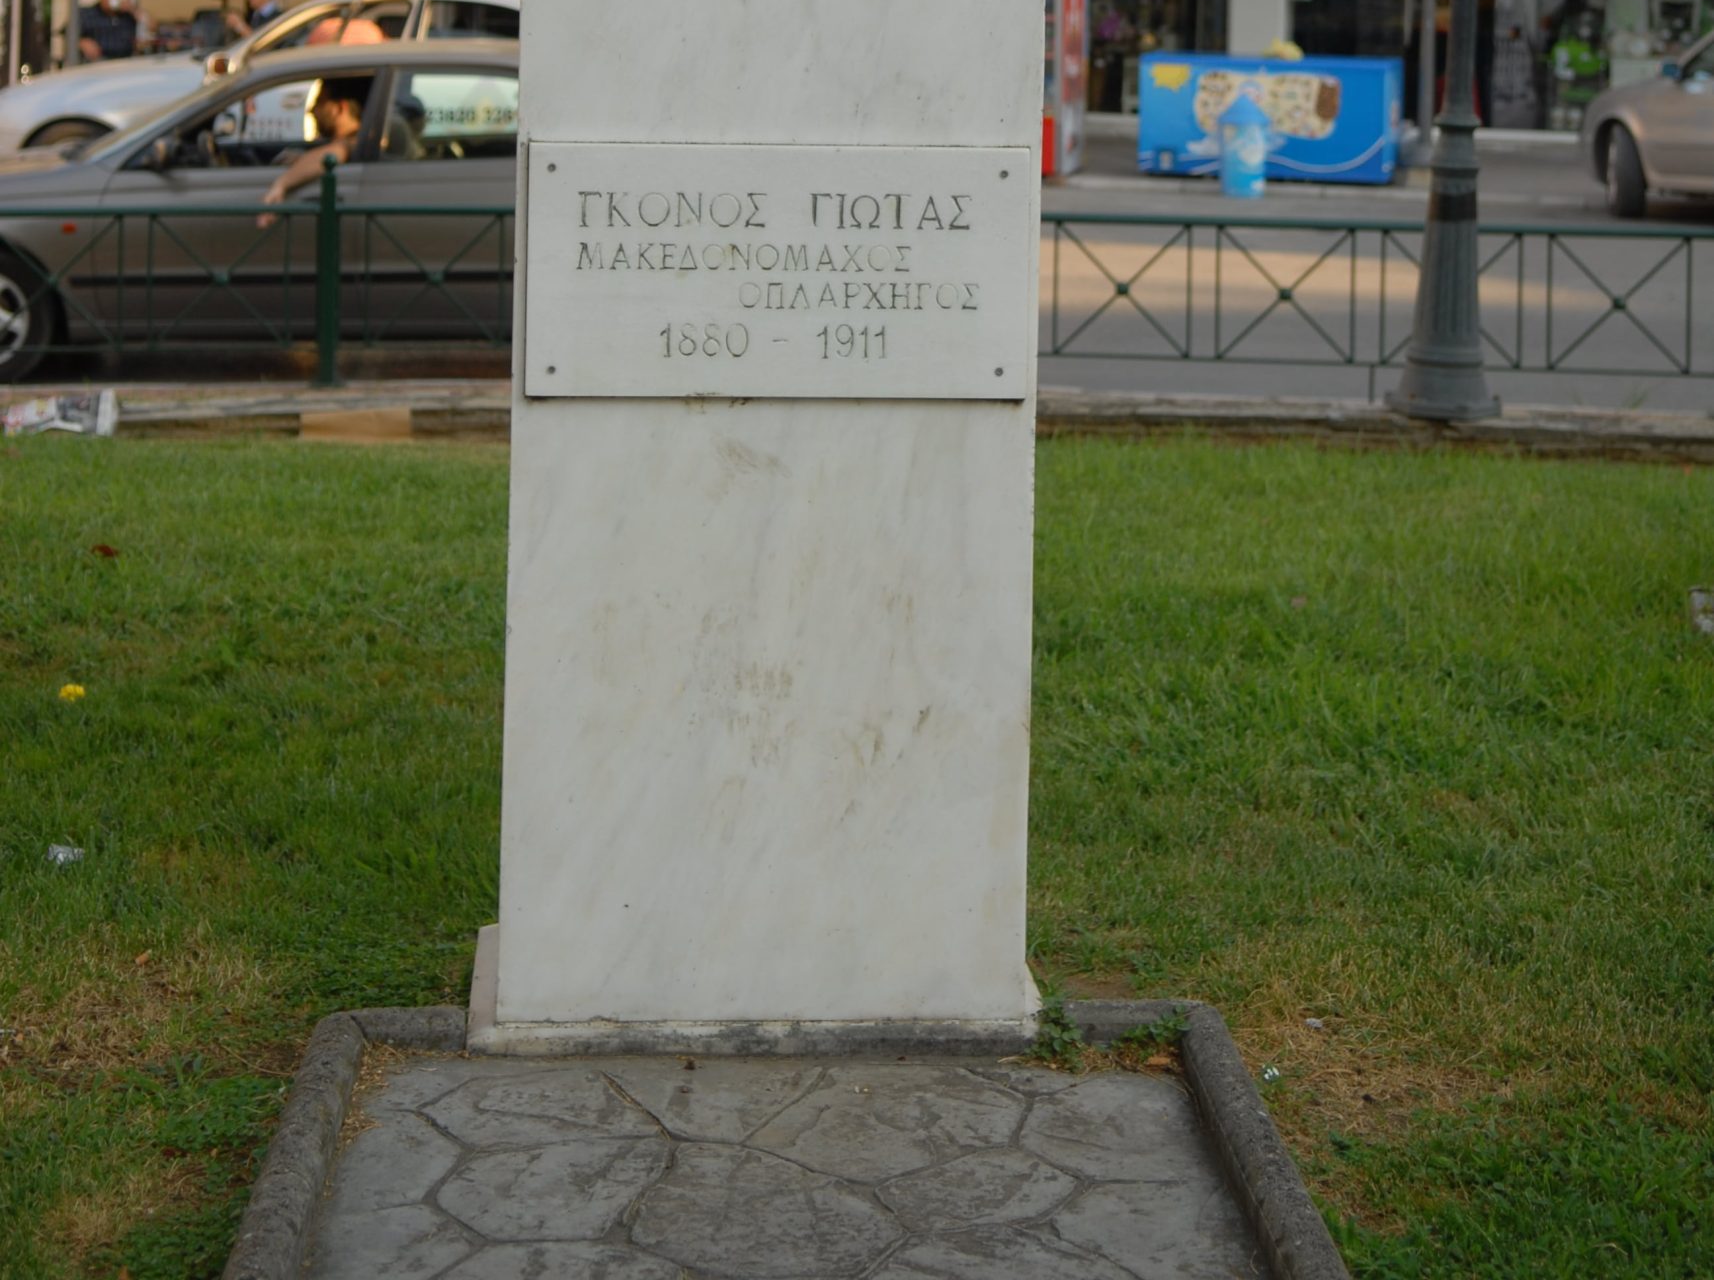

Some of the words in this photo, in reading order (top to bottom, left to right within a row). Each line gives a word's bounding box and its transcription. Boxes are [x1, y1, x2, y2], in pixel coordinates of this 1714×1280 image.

[578, 191, 767, 228] ΓΚΟΝΟΣ
[810, 193, 972, 230] ΓΙΩΤΑΣ
[576, 242, 912, 273] ΜΑΚΕΔΟΝΟΜΑΧΟΣ
[738, 281, 981, 311] ΟΠΛΑΡΧΗΓΟΣ
[658, 322, 750, 359] 1880
[816, 323, 889, 360] 1911
